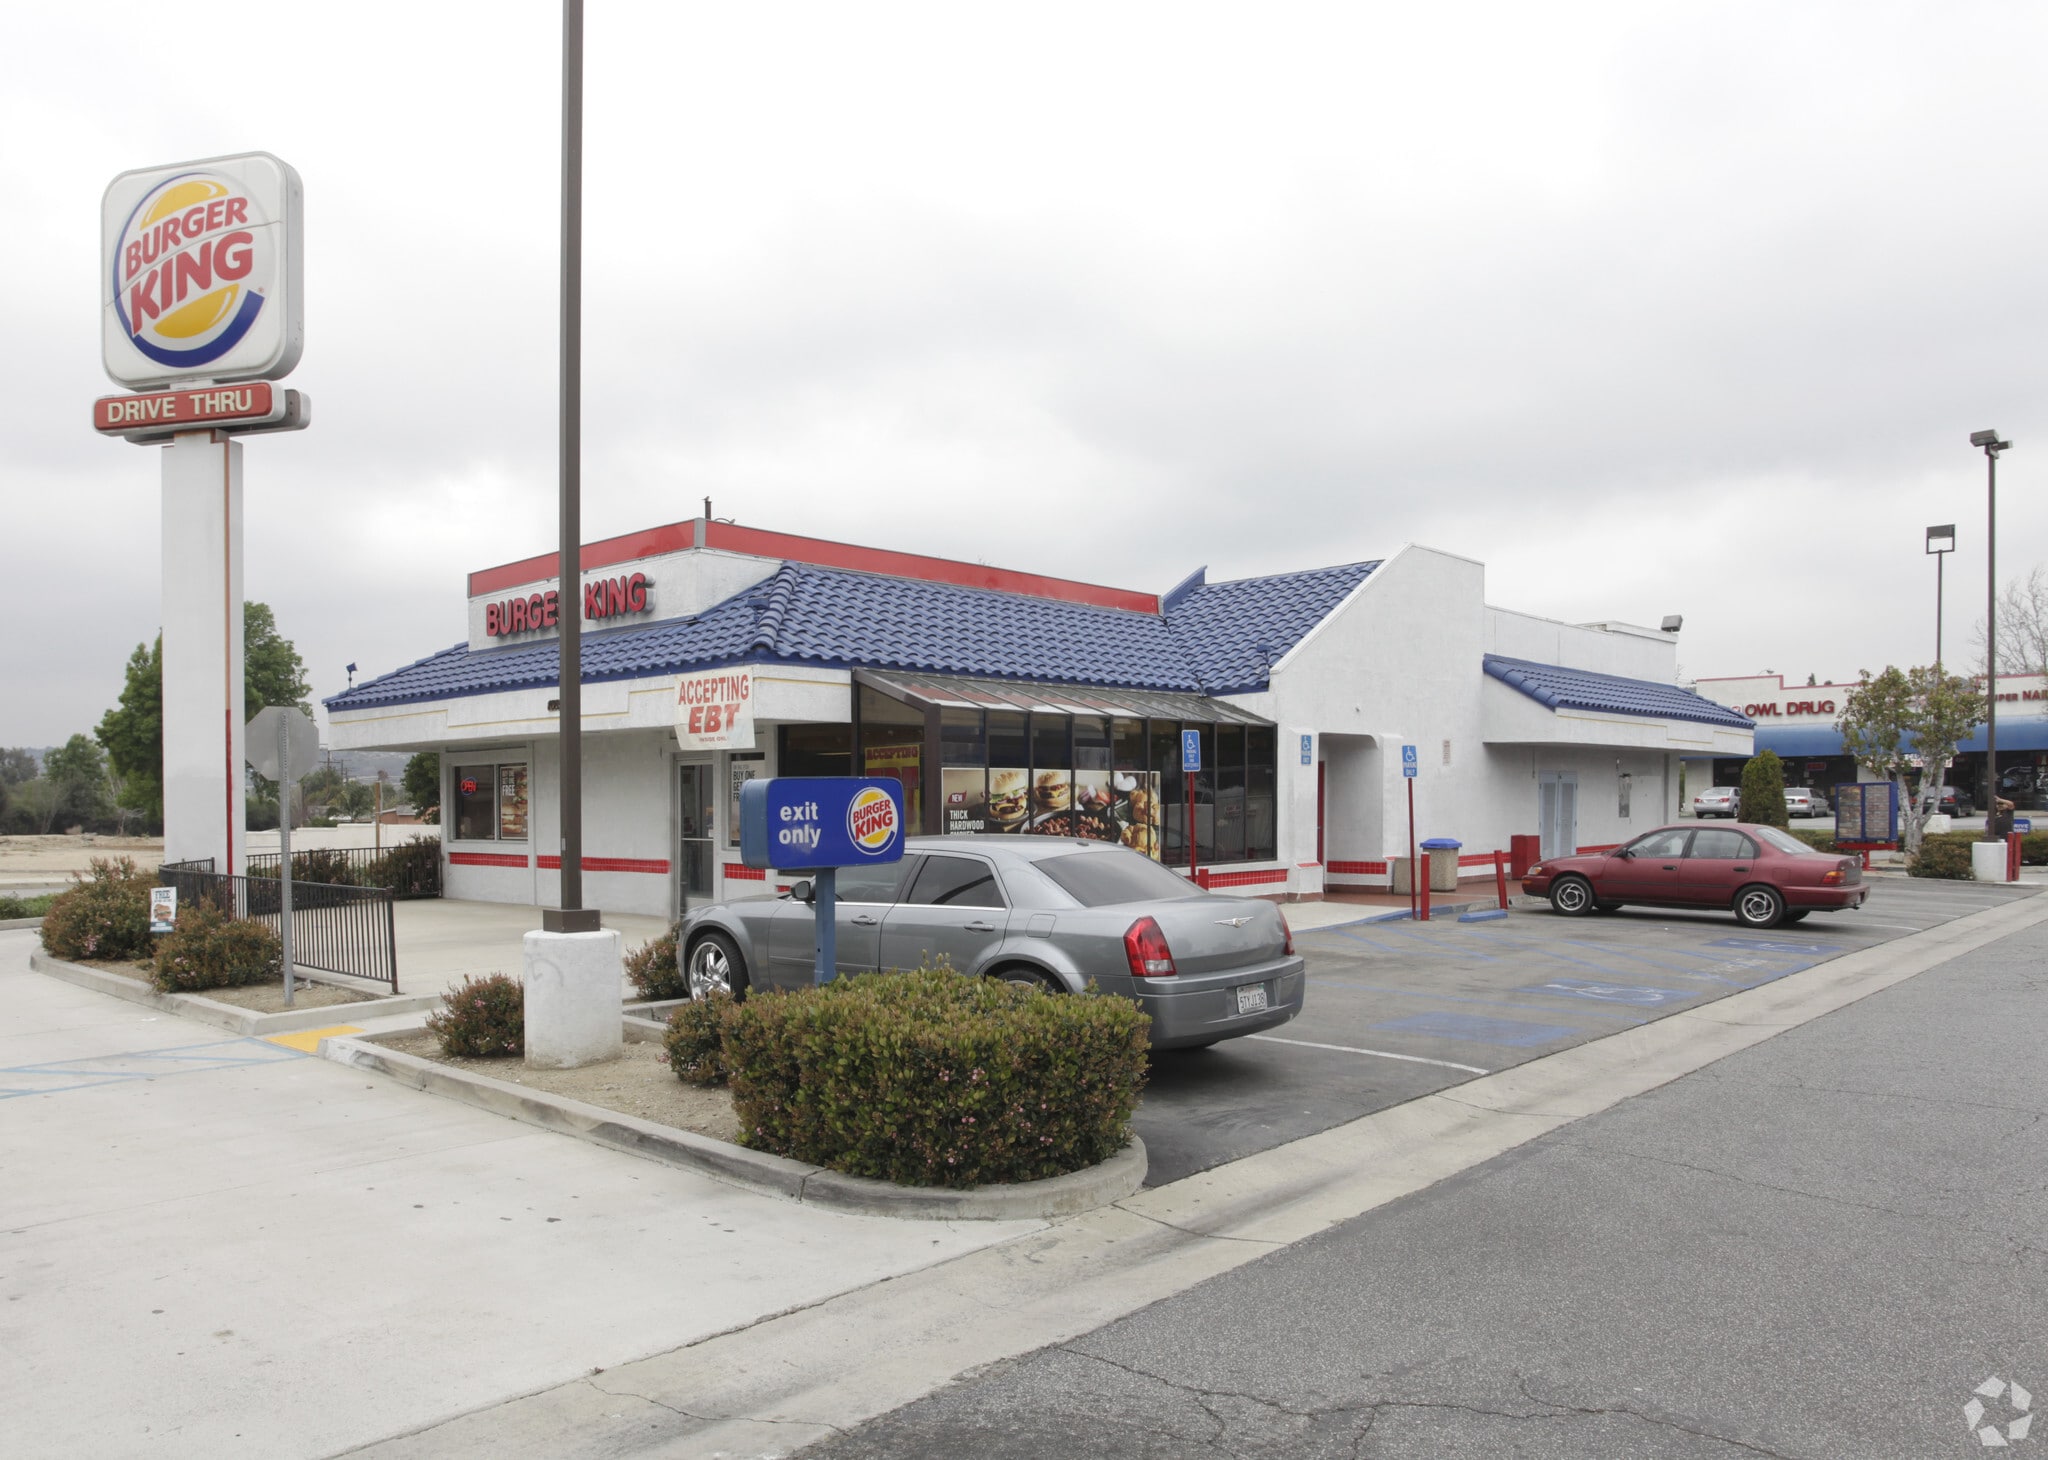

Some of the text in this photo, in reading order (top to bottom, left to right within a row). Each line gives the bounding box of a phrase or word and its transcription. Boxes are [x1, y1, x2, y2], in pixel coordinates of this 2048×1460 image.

[126, 197, 248, 282] BURGER
[130, 231, 253, 336] KING
[107, 389, 253, 423] DRIVE THRU
[486, 572, 648, 637] BURGE KING
[678, 674, 749, 705] ACCEPTING
[688, 703, 741, 734] EBT
[1744, 700, 1835, 717] OWL DRUG
[866, 746, 918, 760] ACCEPTING
[461, 780, 477, 792] OPEN
[502, 784, 515, 797] FREE
[950, 794, 963, 803] NEW
[780, 801, 819, 822] exit
[853, 799, 892, 825] BURGER
[949, 810, 968, 820] THICK
[778, 824, 822, 848] only
[854, 810, 893, 843] KING
[949, 820, 985, 831] HARDWOOD
